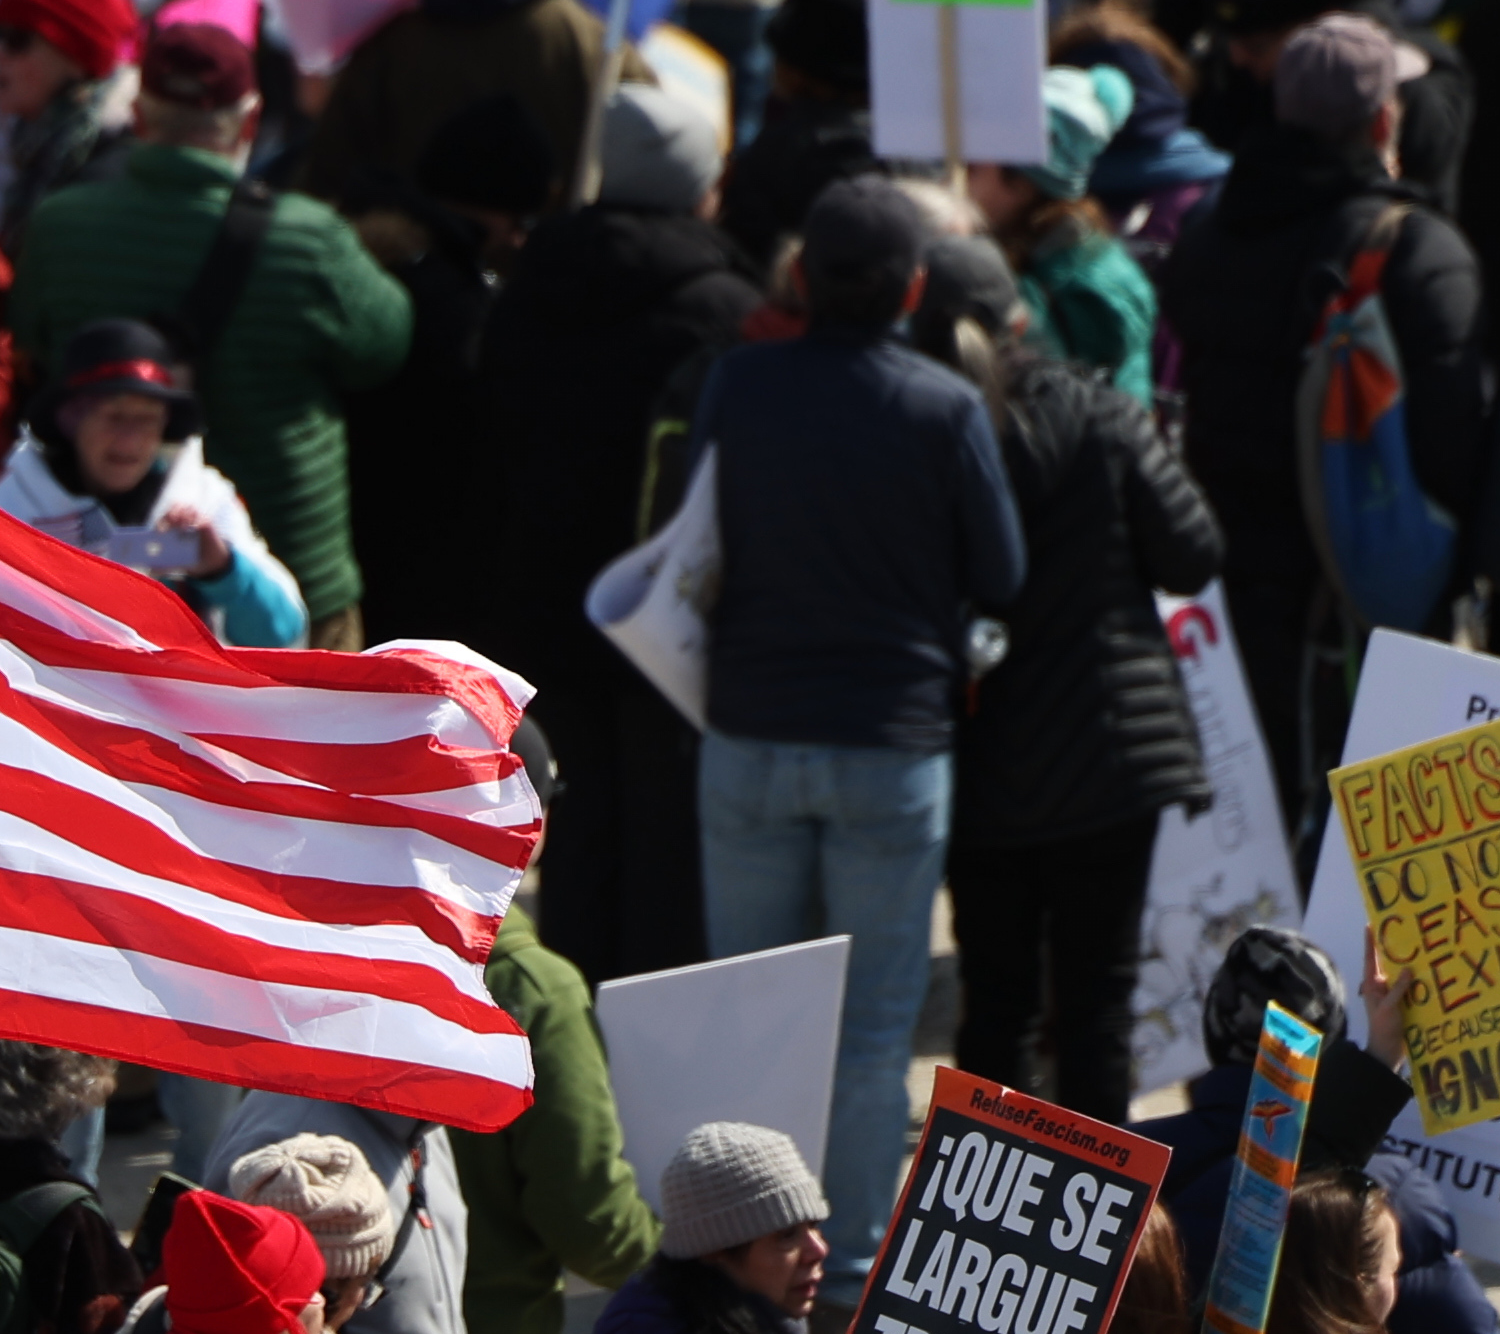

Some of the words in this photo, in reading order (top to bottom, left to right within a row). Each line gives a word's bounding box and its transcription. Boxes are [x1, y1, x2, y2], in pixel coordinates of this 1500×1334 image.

[1363, 858, 1431, 913] DO
[970, 1088, 1131, 1168] RefuseFascism.org
[918, 1130, 1056, 1239] ¡QUE
[1051, 1170, 1133, 1266] SE
